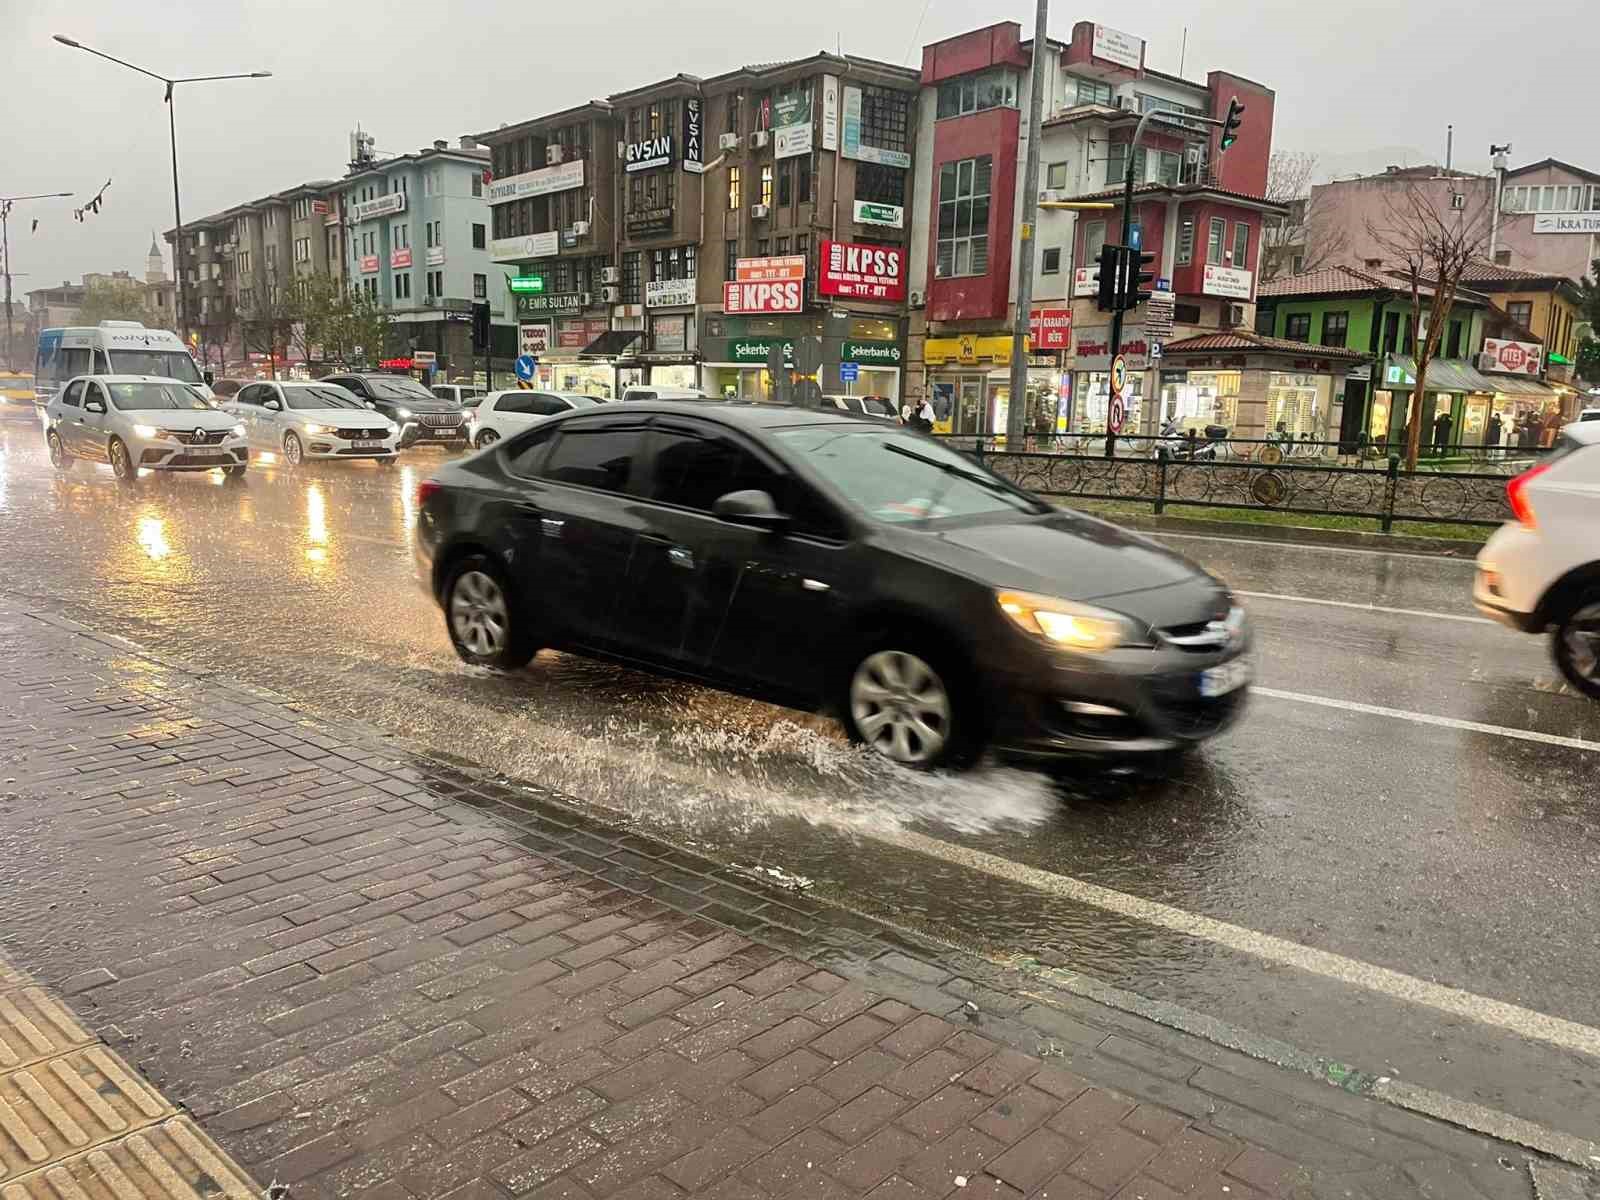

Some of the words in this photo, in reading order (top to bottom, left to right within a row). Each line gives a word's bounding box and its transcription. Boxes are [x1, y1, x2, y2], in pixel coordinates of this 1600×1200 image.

[847, 247, 899, 277] KPSS
[548, 295, 579, 309] SULTAN
[743, 282, 799, 310] KPSS
[850, 346, 890, 359] Şekerbank
